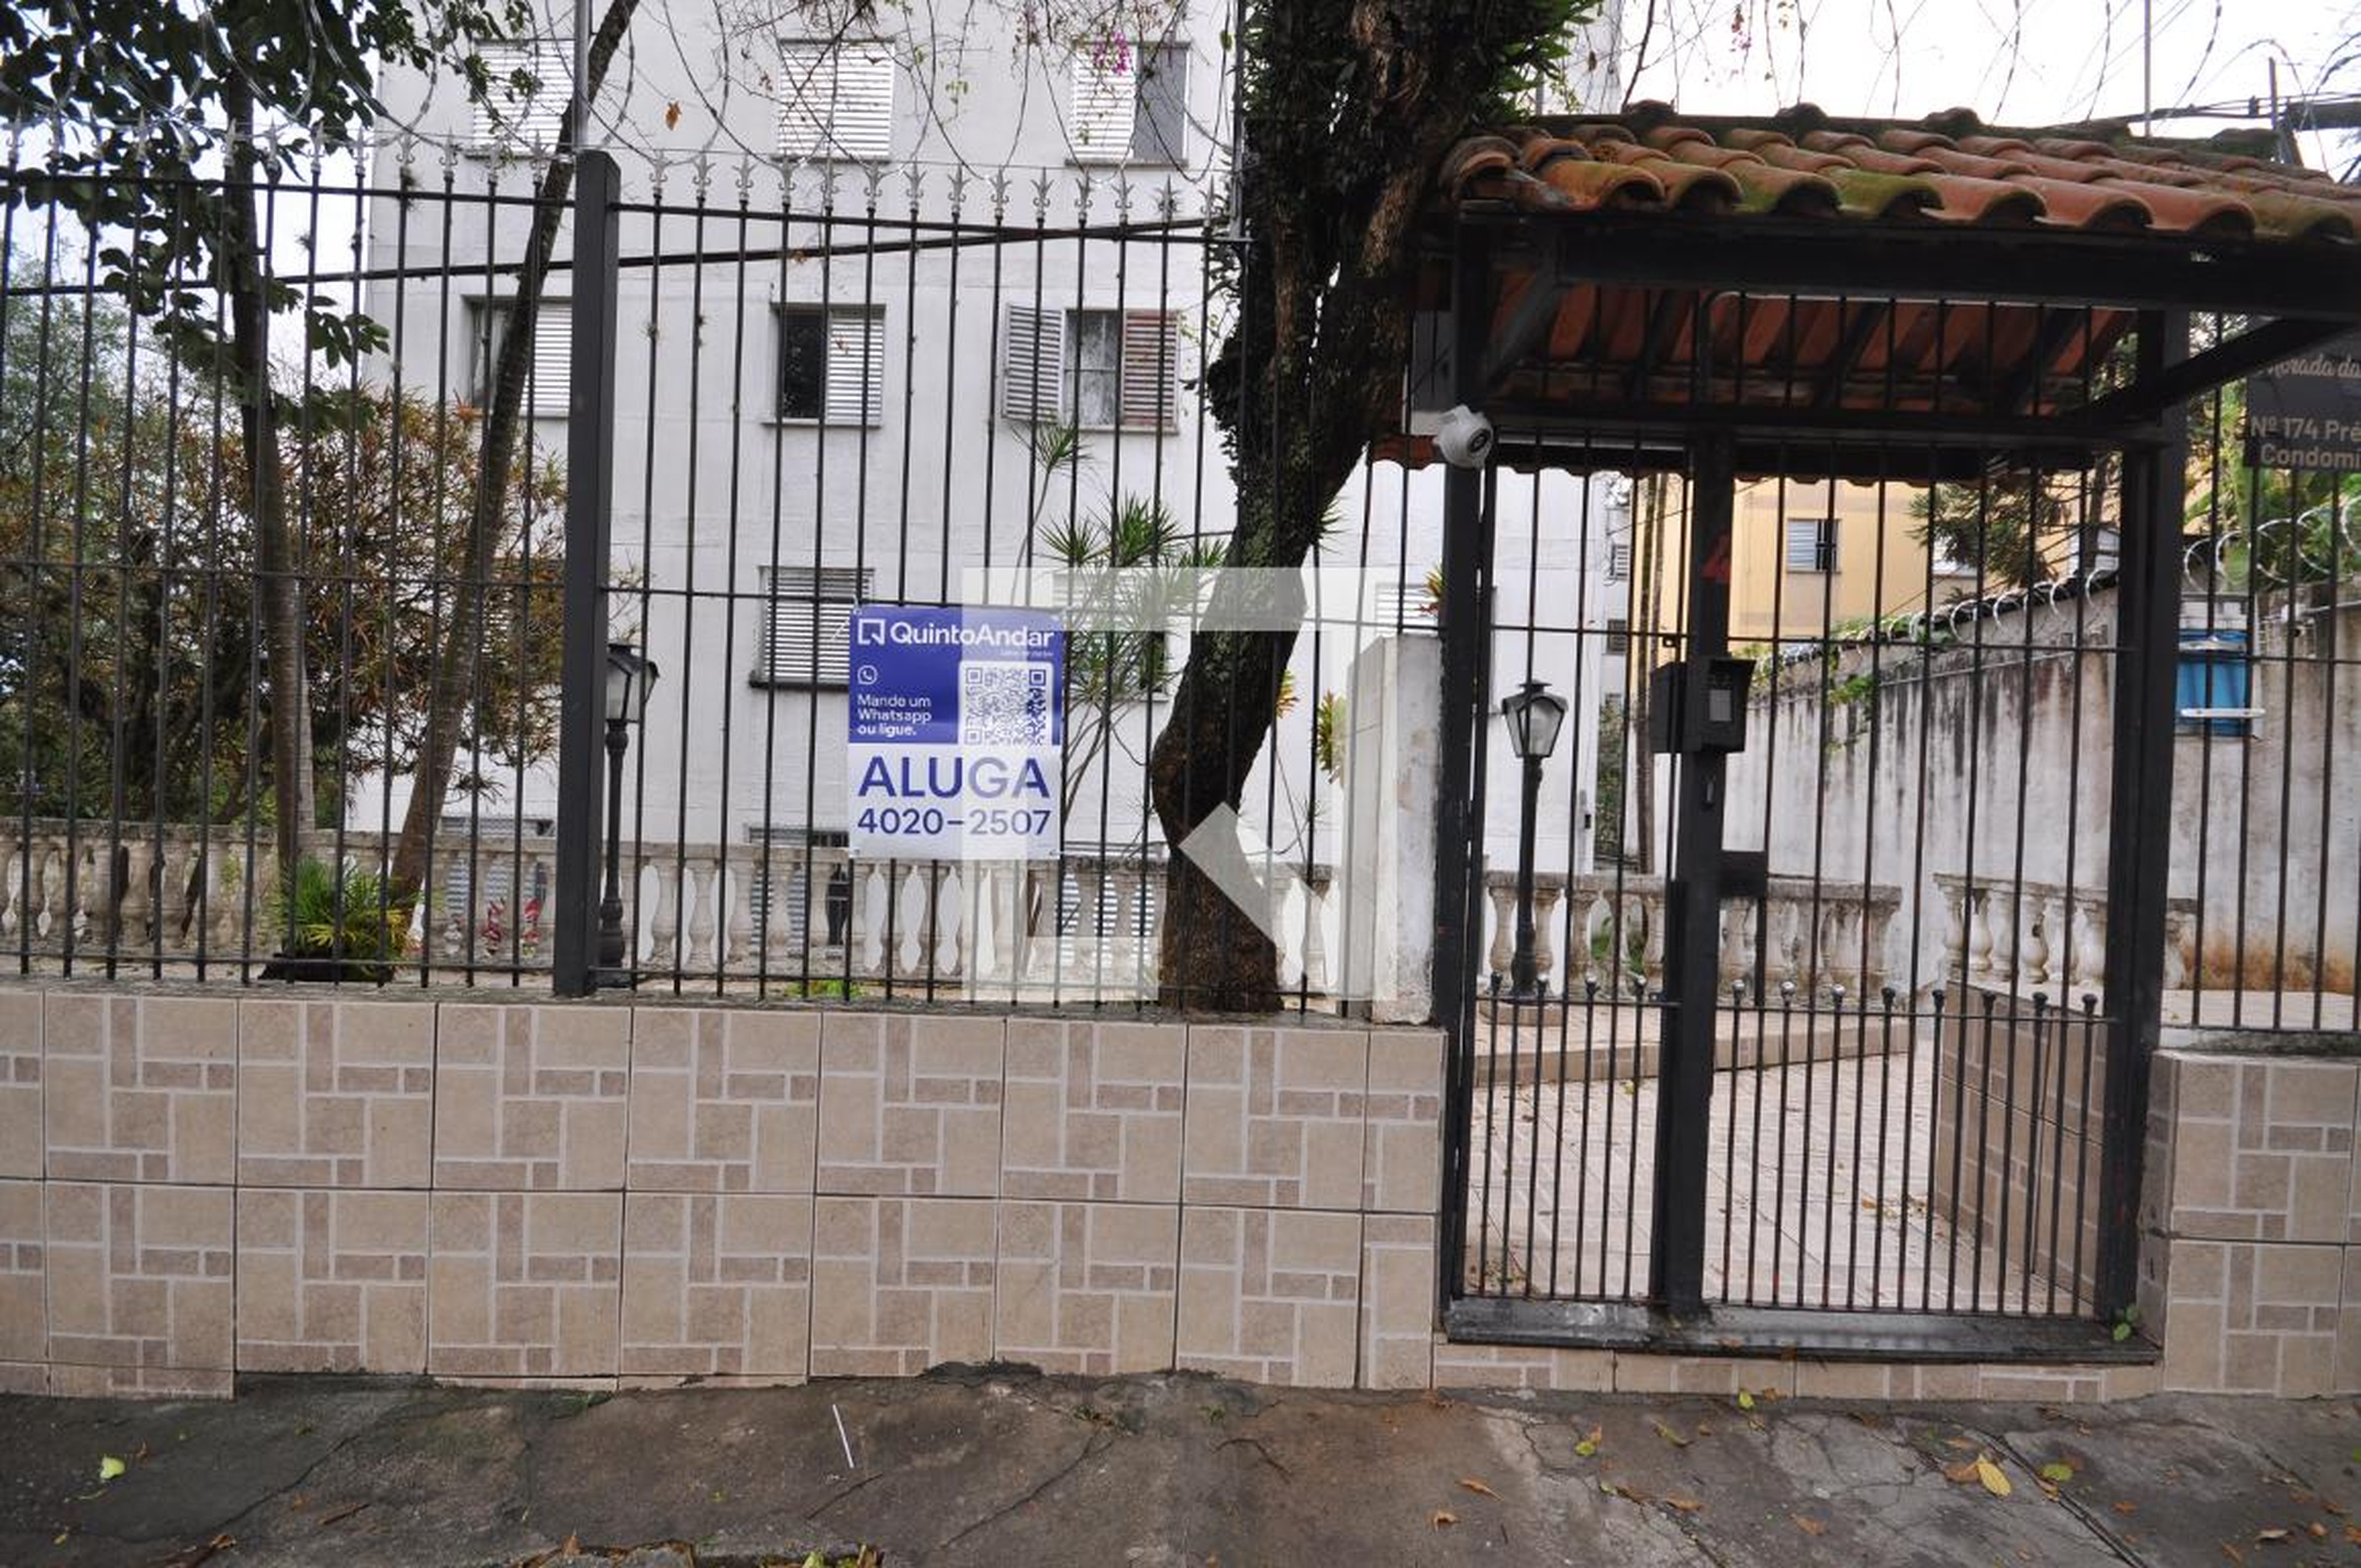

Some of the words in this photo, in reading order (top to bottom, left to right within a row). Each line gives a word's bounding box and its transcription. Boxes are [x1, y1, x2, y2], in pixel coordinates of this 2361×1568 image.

[2284, 417, 2318, 440] 174
[890, 621, 1054, 647] QuintoAndar
[909, 697, 932, 707] um
[858, 708, 932, 725] Whatsapp
[858, 725, 876, 735] ou
[858, 756, 1050, 798] ALUGA
[858, 808, 1051, 835] 4020-2507
